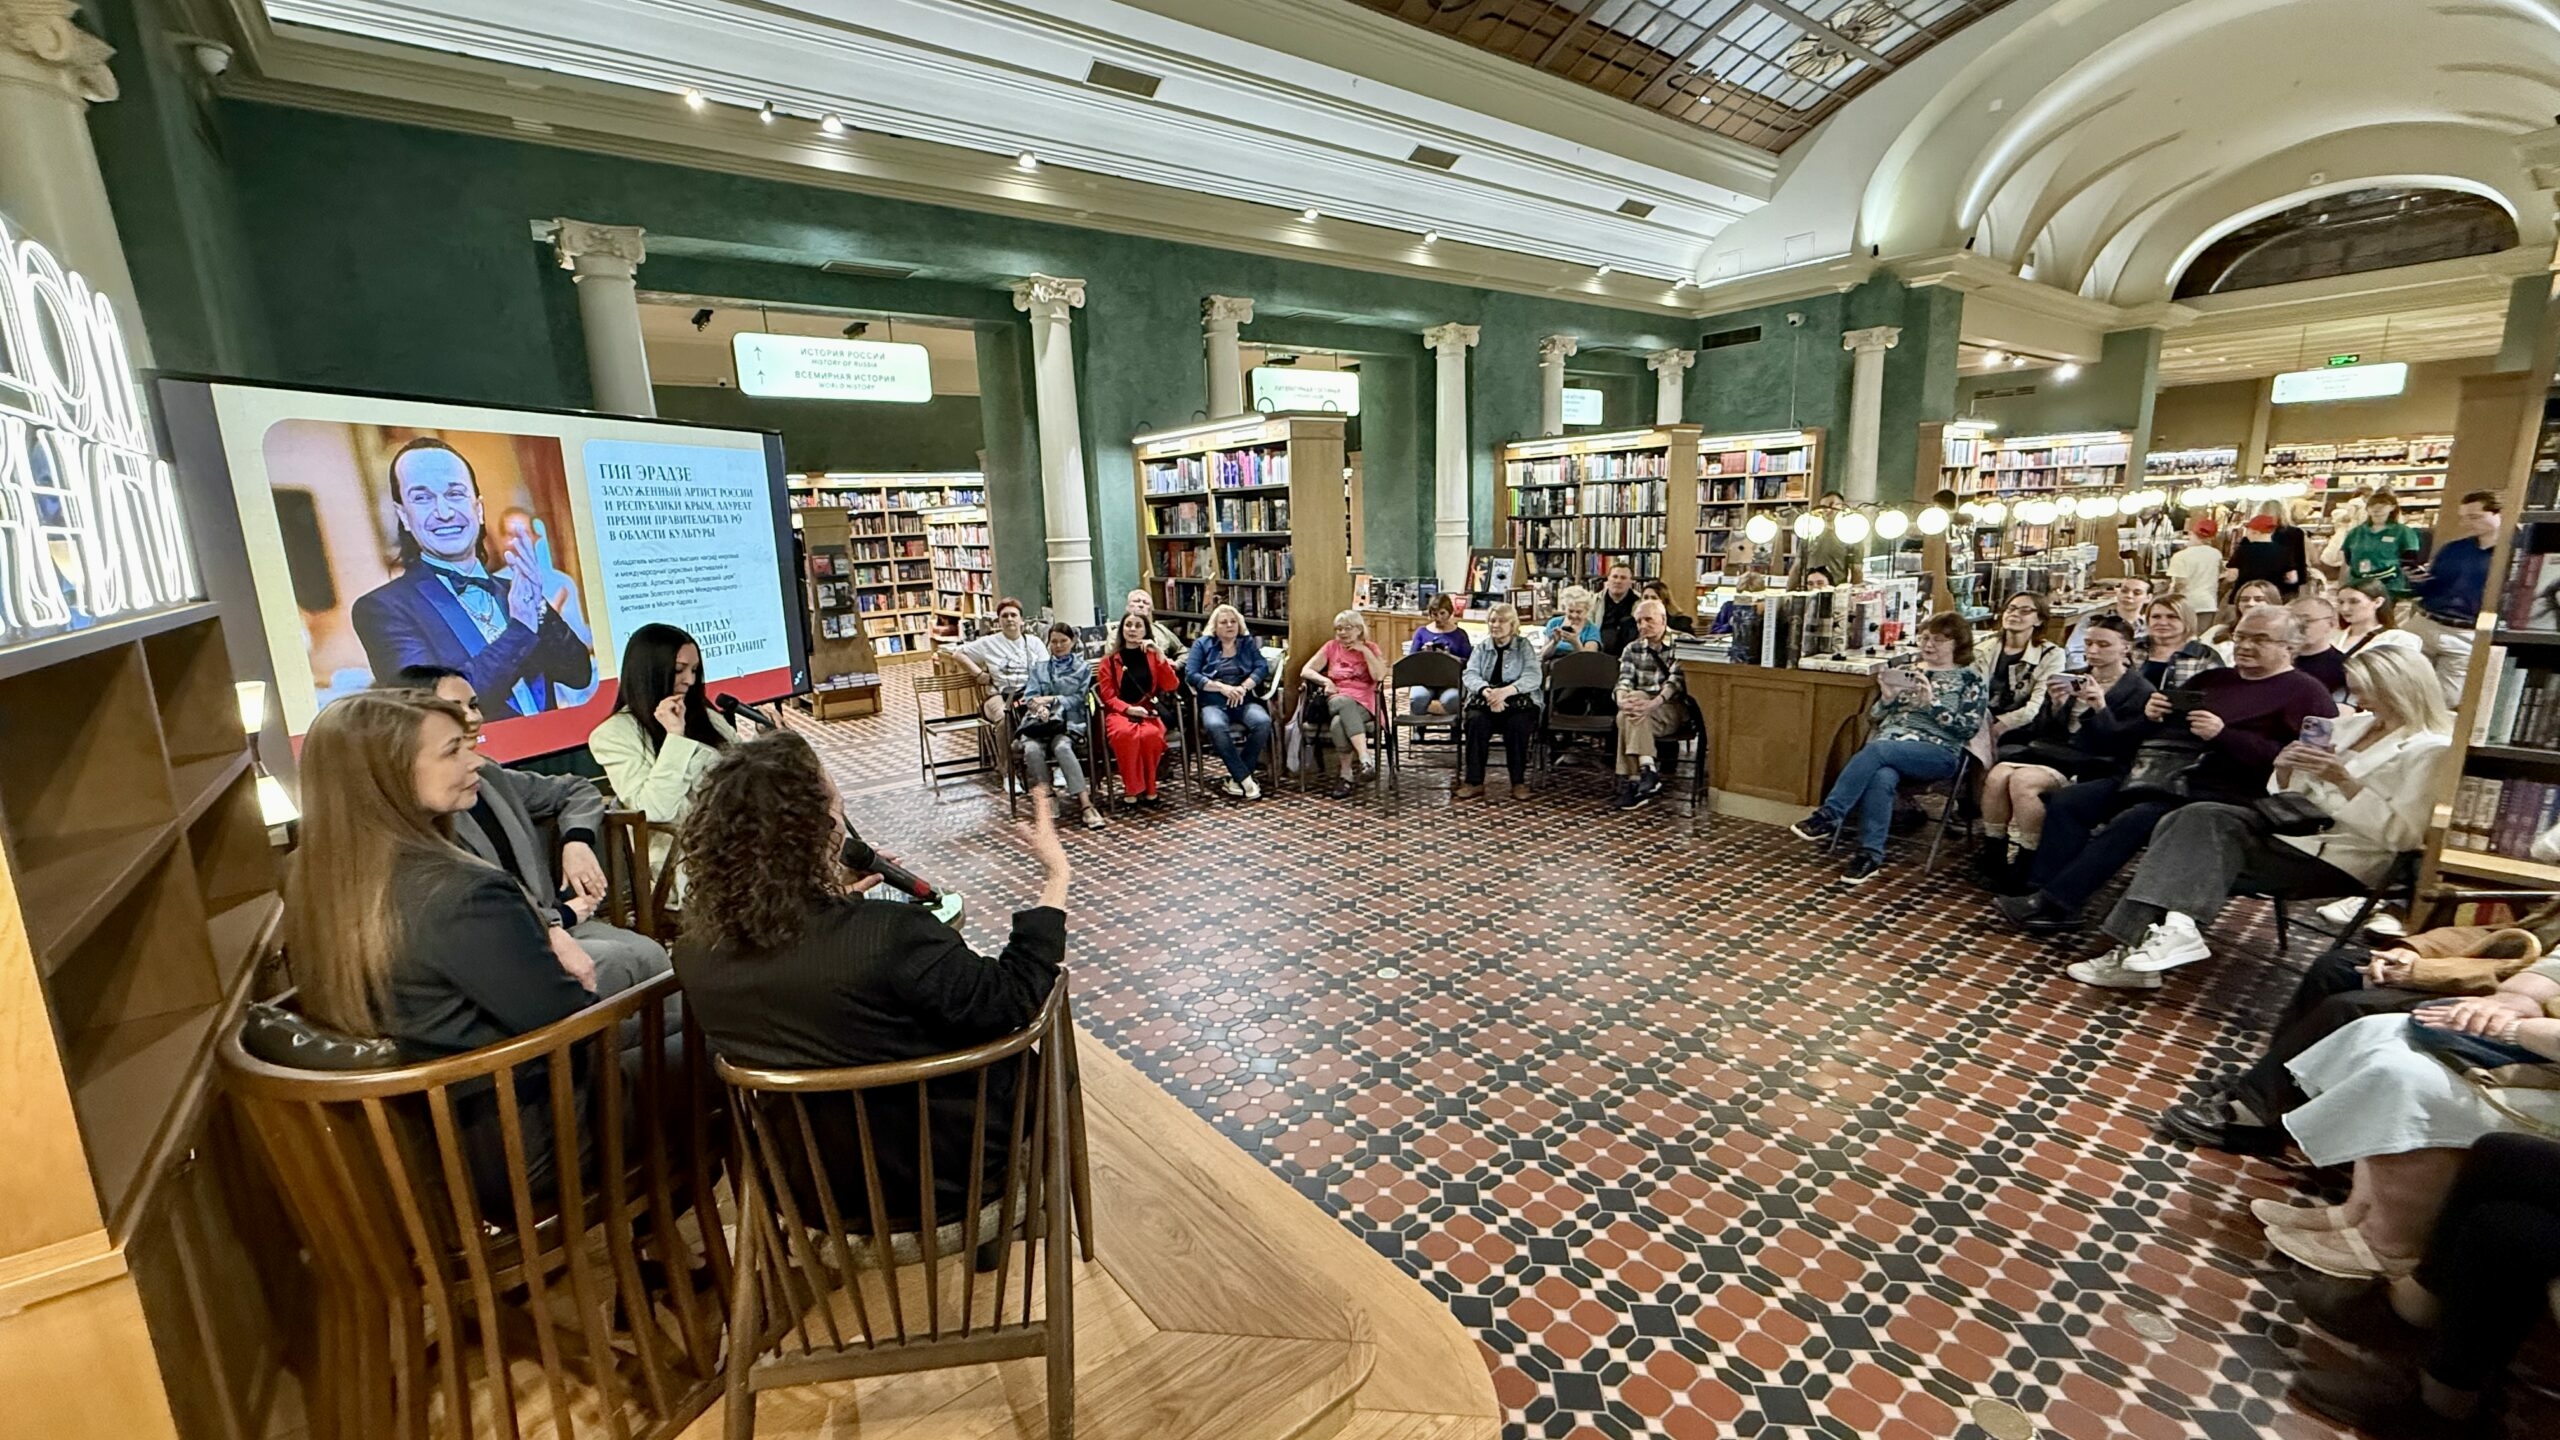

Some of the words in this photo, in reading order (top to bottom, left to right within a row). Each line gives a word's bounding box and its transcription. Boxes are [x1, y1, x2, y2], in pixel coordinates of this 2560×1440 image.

[800, 348, 845, 357] ИСТОРИЯ
[847, 350, 886, 360] РОССИИ
[794, 370, 852, 380] ВСЕМИРНАЯ
[854, 373, 896, 382] ИСТОРИЯ
[599, 463, 632, 480] ГИЯ
[635, 464, 693, 483] ЭРАДЗЕ
[601, 485, 682, 497] ЗАСЛУЖЕННЫЙ
[684, 487, 717, 497] АРТИСТ
[719, 487, 754, 498] РОССИИ
[605, 500, 613, 511] И
[616, 500, 682, 511] РЕСПУБЛИКИ
[717, 501, 752, 511] ЛАУРЕАТ
[606, 515, 652, 526] ПРЕМИИ
[654, 514, 729, 525] ПРАВИТЕЛЬСТВА
[730, 513, 743, 525] РФ
[609, 530, 617, 541] В
[619, 529, 667, 541] ОБЛАСТИ
[668, 527, 716, 539] КУЛЬТУРЫ
[685, 618, 732, 634] НАГРАДУ
[694, 631, 737, 646] ОДНОГО
